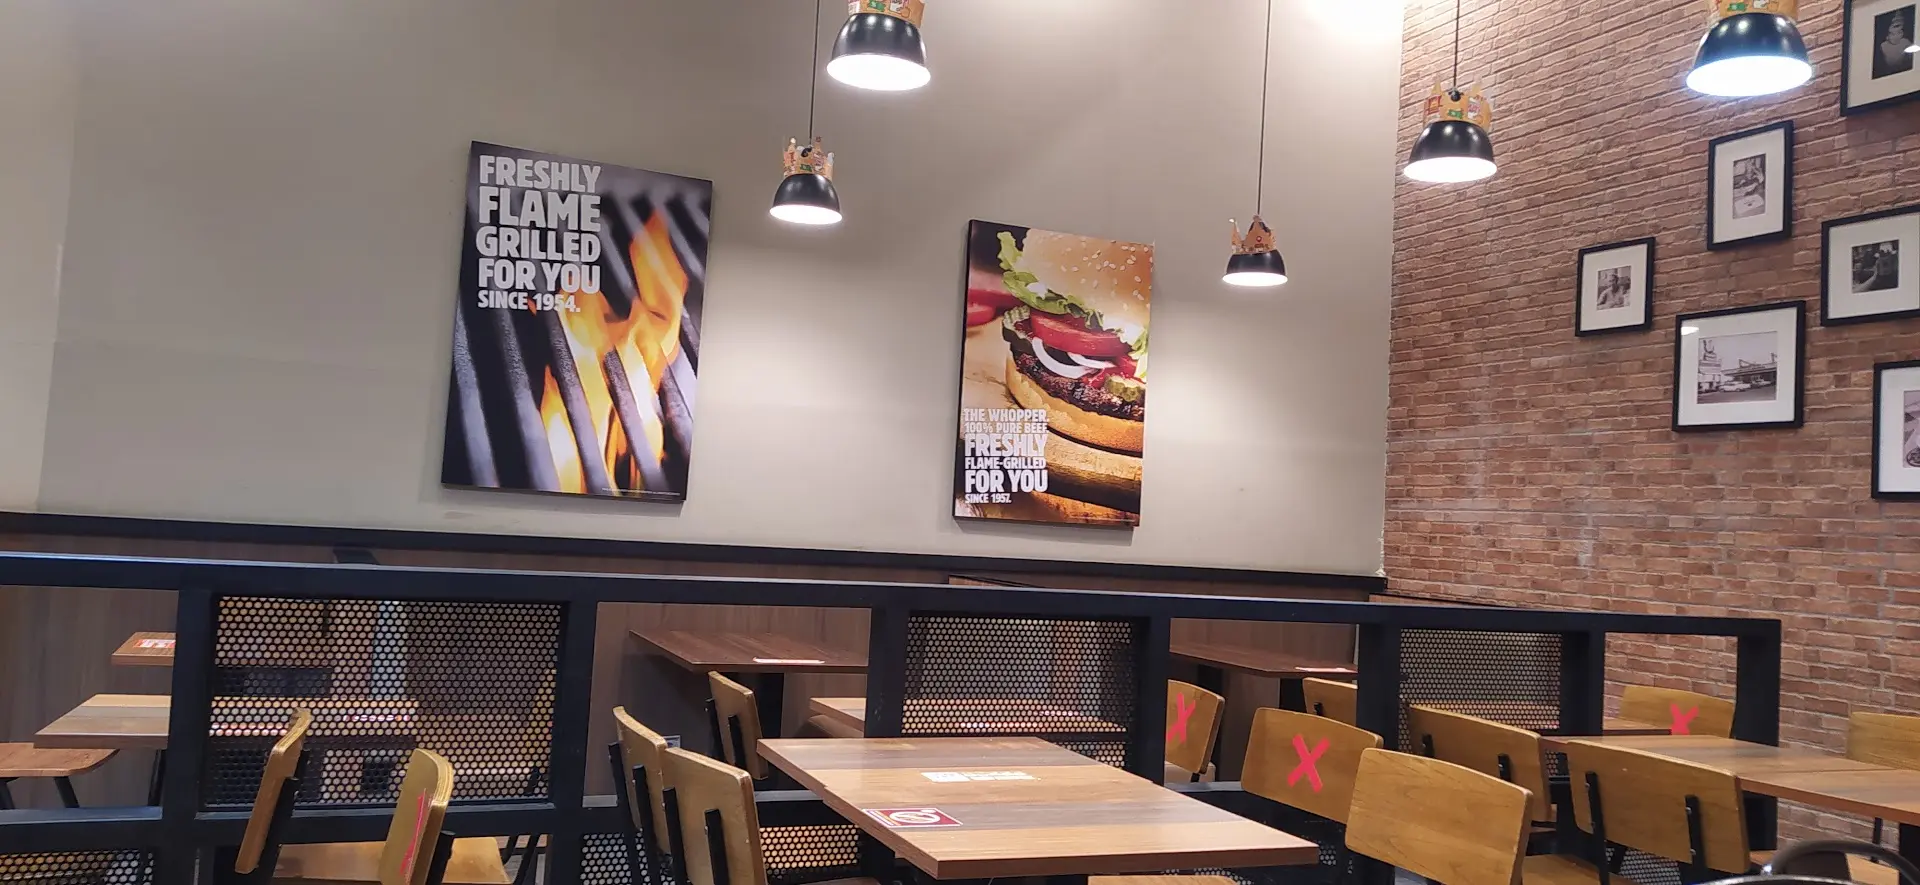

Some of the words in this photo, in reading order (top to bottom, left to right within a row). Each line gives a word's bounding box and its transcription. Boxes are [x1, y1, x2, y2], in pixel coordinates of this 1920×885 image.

[479, 154, 601, 193] FRESHLY
[478, 186, 601, 232] FLAME
[476, 226, 601, 262] GRILLED
[478, 258, 536, 290] FOR
[542, 262, 601, 294] YOU
[477, 290, 528, 310] SINCE
[533, 293, 580, 312] 1954.
[964, 408, 985, 421] THE
[988, 408, 1049, 422] WHOPPER.
[964, 422, 993, 433] 100%
[996, 422, 1022, 433] PURE
[965, 433, 1047, 457] FRESHLY
[965, 457, 1046, 469] FLAME-GRILLED
[965, 470, 1004, 492] FOR
[1008, 470, 1048, 493] YOU
[965, 493, 989, 503] SINCE
